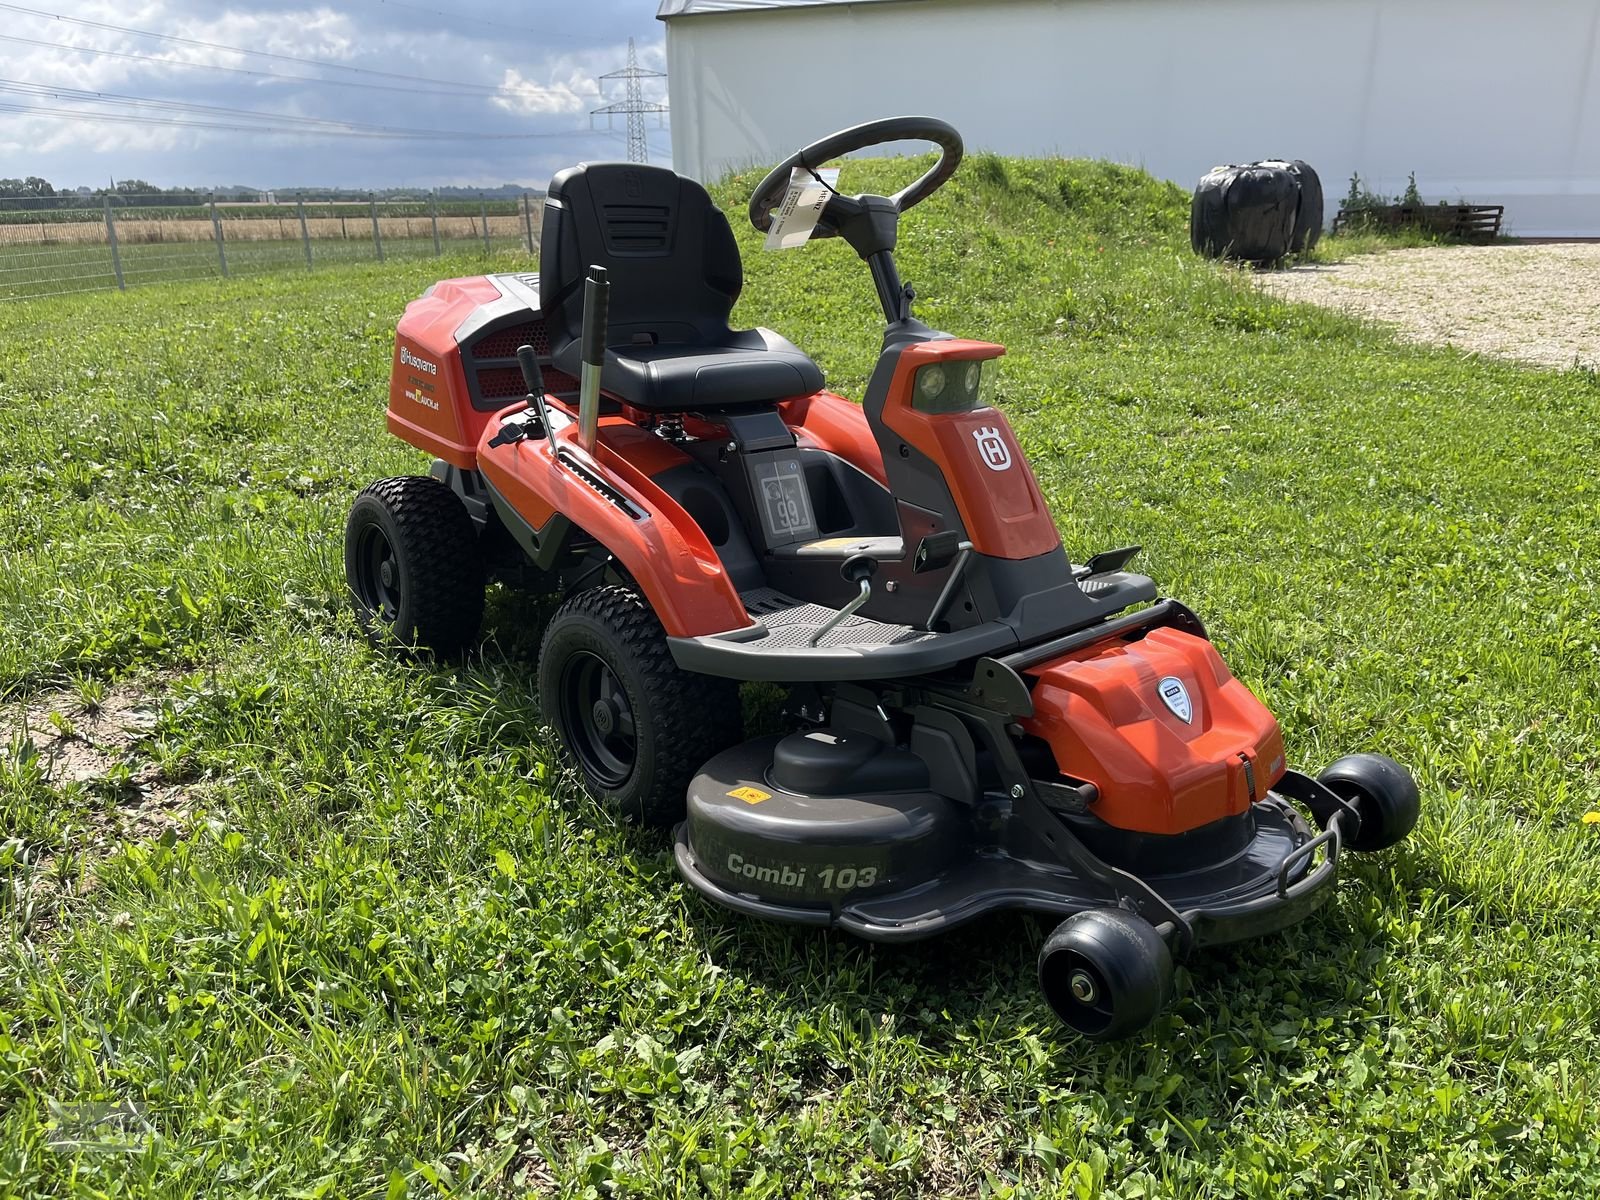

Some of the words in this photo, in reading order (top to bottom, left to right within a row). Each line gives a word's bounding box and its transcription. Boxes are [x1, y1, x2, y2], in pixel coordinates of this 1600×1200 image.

[813, 190, 829, 211] HEINZ
[406, 350, 437, 375] Husqvarna
[777, 500, 800, 528] 99
[727, 853, 806, 887] Combi
[817, 867, 878, 889] 103
